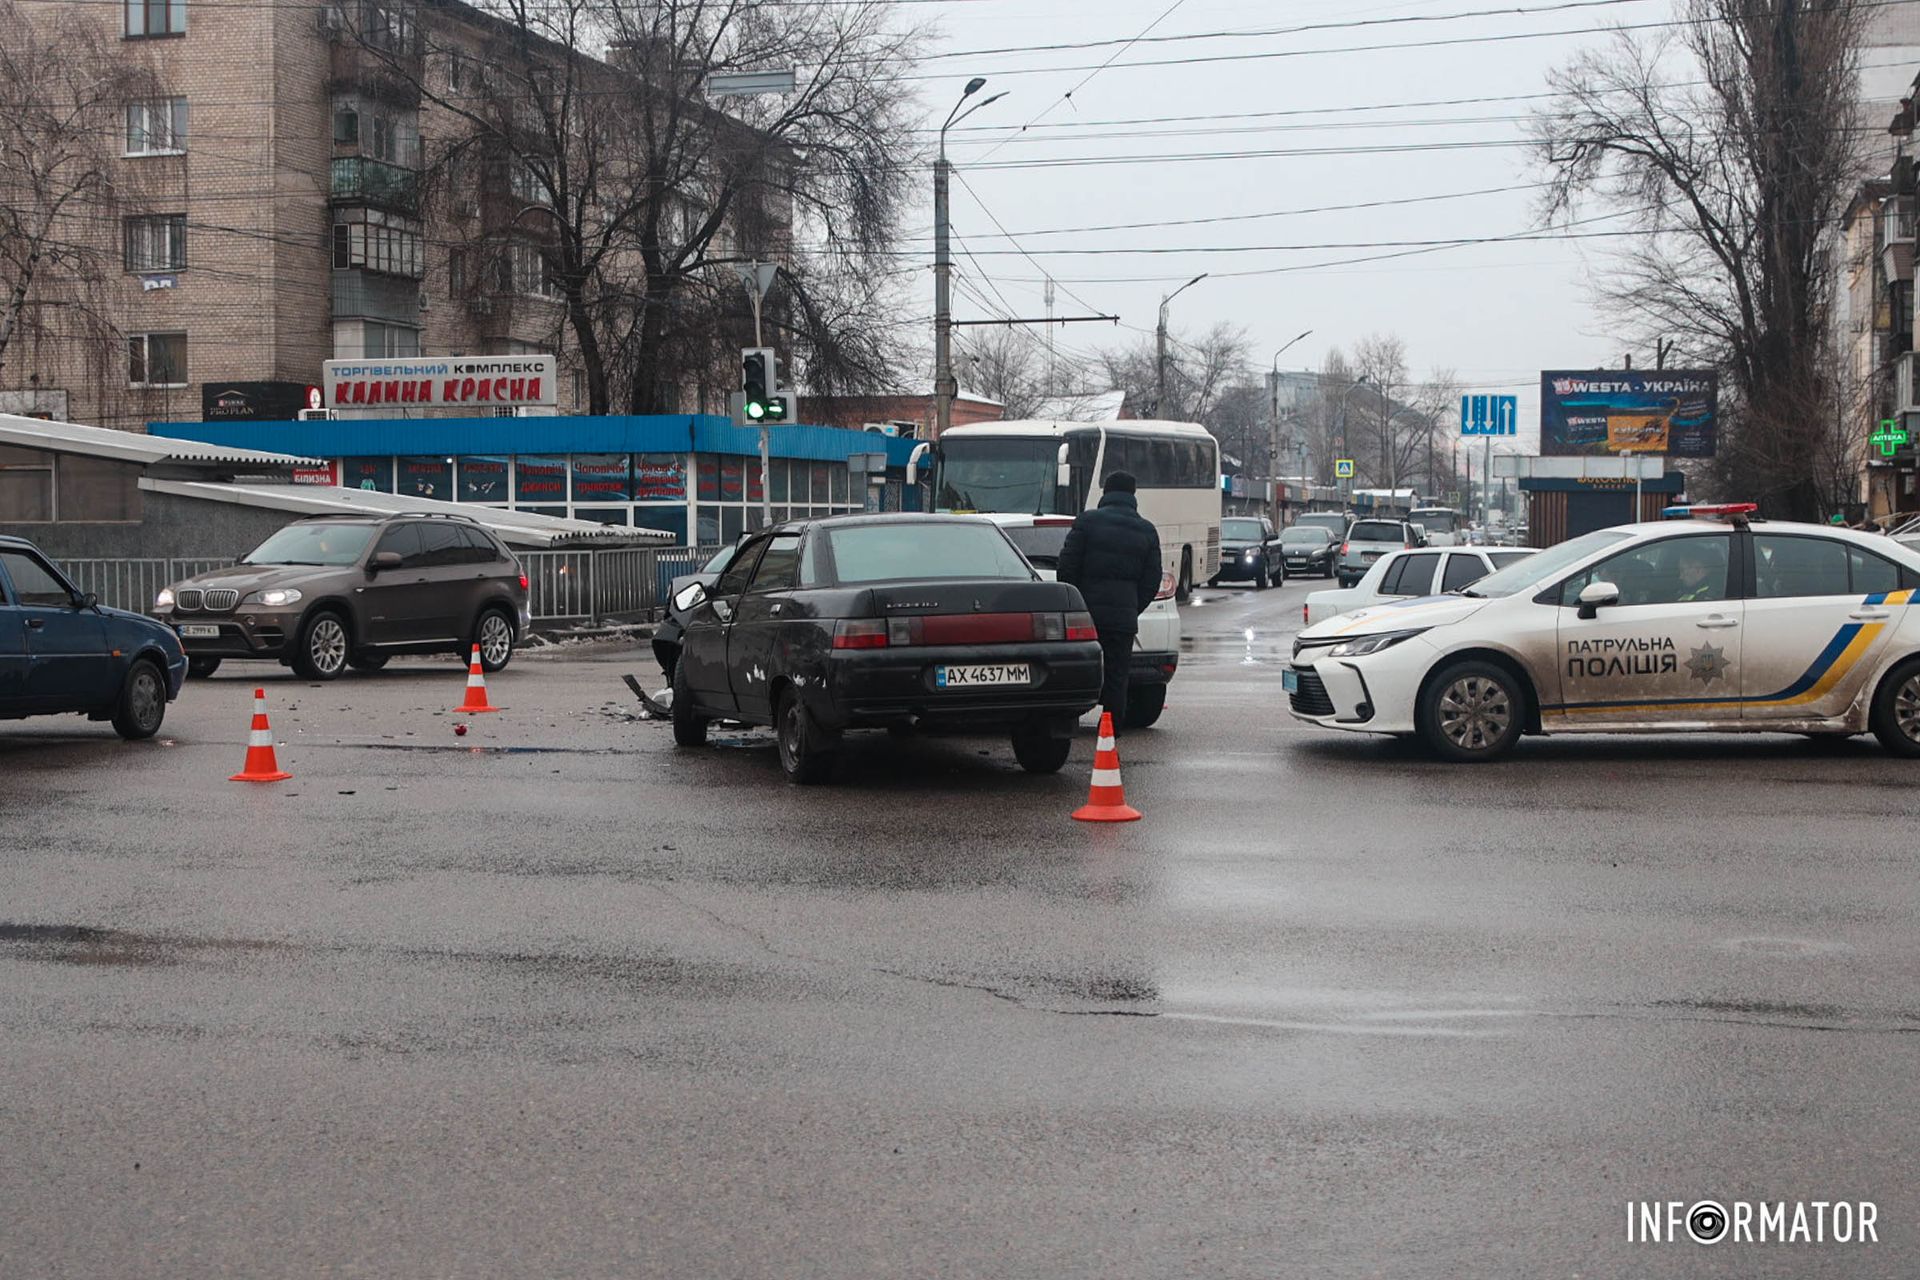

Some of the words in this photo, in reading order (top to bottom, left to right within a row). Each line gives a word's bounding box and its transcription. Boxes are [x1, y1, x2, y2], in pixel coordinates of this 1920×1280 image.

[331, 363, 448, 377] ТОРГІВЕЛЬНИЙ
[454, 362, 545, 374] КОМПЛЕКС
[335, 379, 433, 405] КАЛИНА
[443, 377, 541, 401] КРАСНА
[1573, 381, 1631, 393] WESTA
[1643, 379, 1710, 393] УКРАЇНА
[230, 406, 254, 416] PLAN
[294, 474, 331, 484] БІЛИЗНА
[1567, 637, 1675, 653] ПАТРУЛЬНА
[1567, 654, 1677, 677] ПОЛІЦІЯ
[947, 668, 968, 684] AX
[971, 667, 1003, 682] 4637
[1007, 666, 1028, 681] MM
